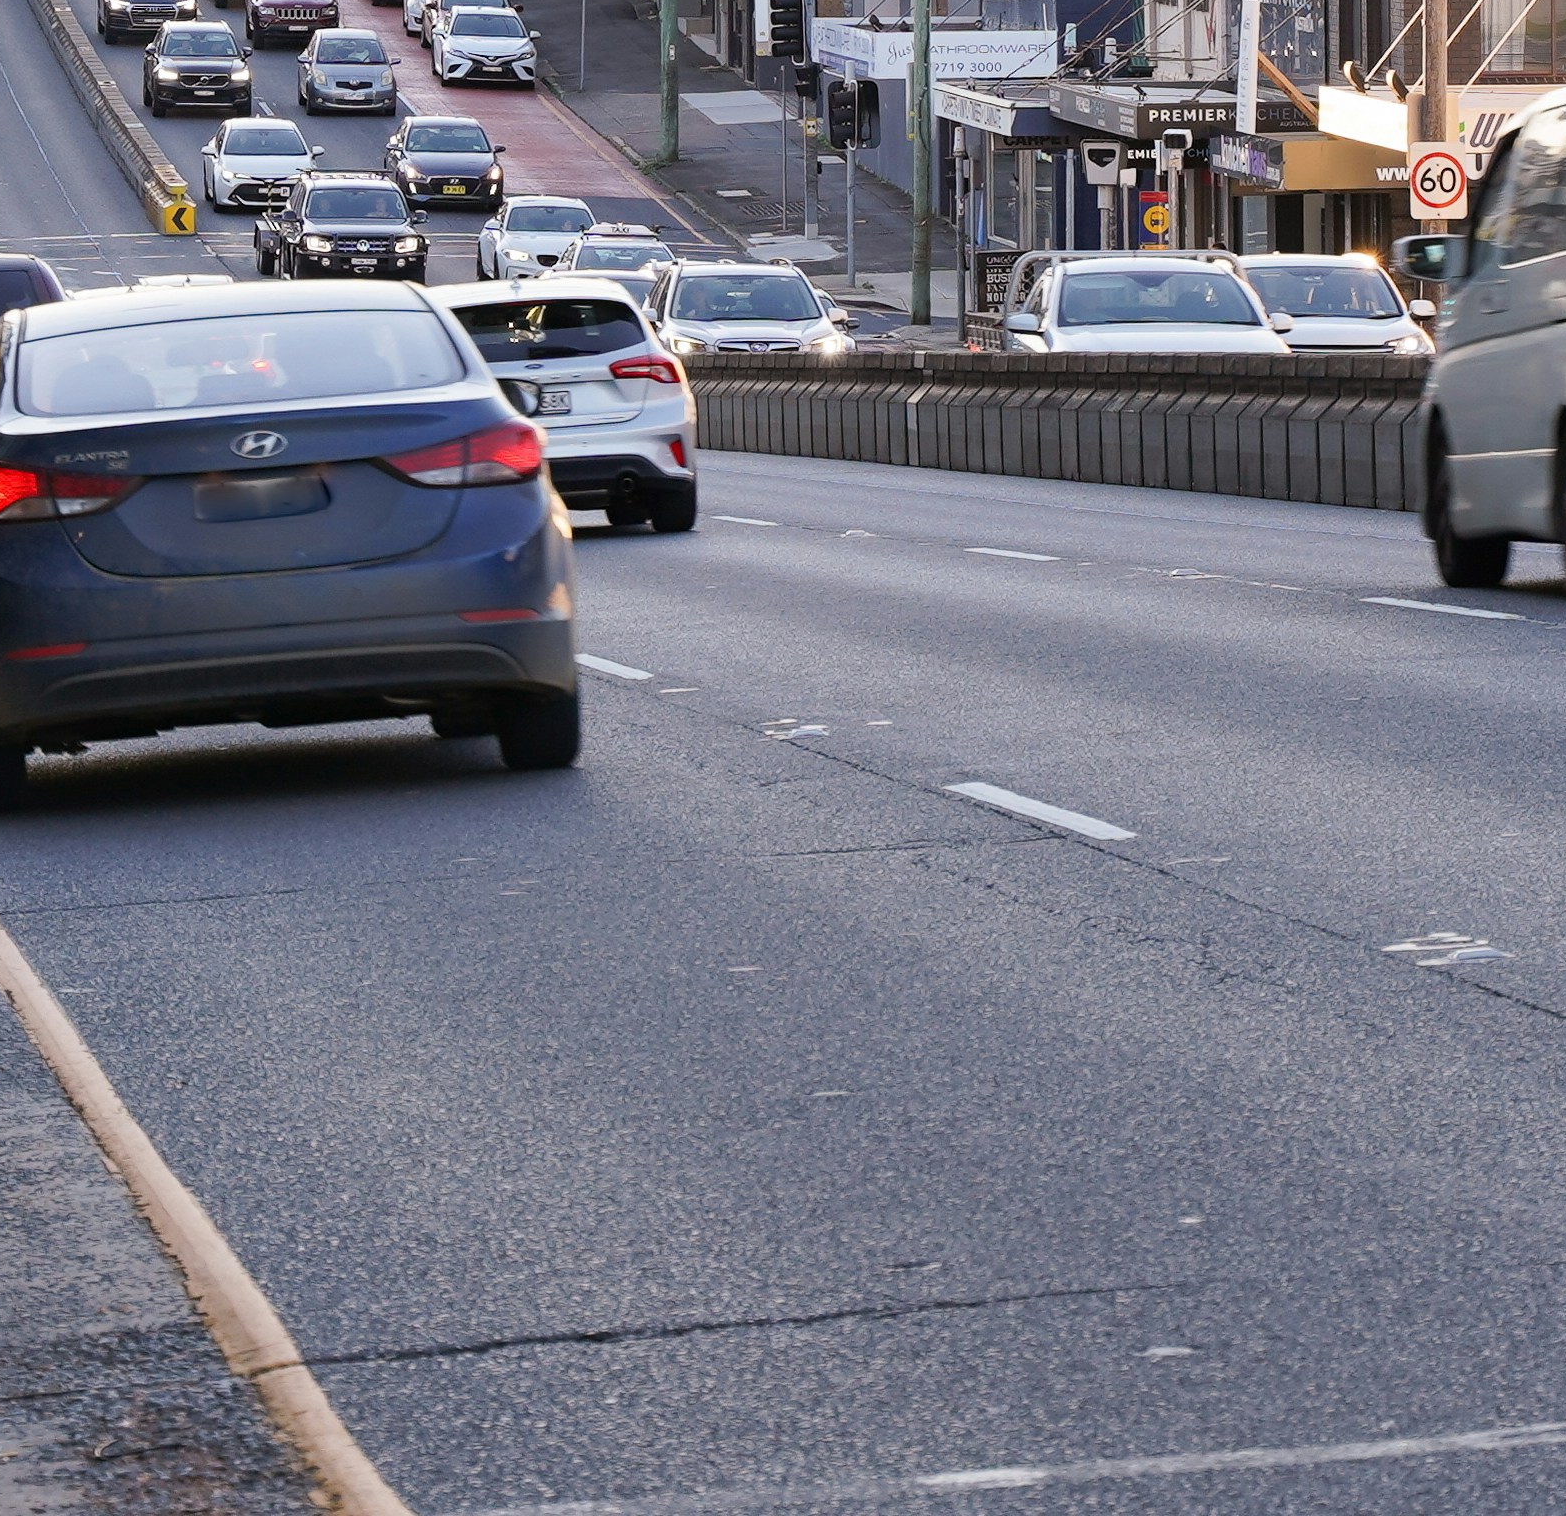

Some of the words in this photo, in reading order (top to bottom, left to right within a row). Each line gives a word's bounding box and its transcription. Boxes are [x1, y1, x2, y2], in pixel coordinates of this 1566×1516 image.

[930, 44, 1047, 54] ATHROOMWARE
[970, 62, 1002, 73] 3000
[1420, 166, 1456, 194] 60
[55, 450, 129, 464] ELANTRA
